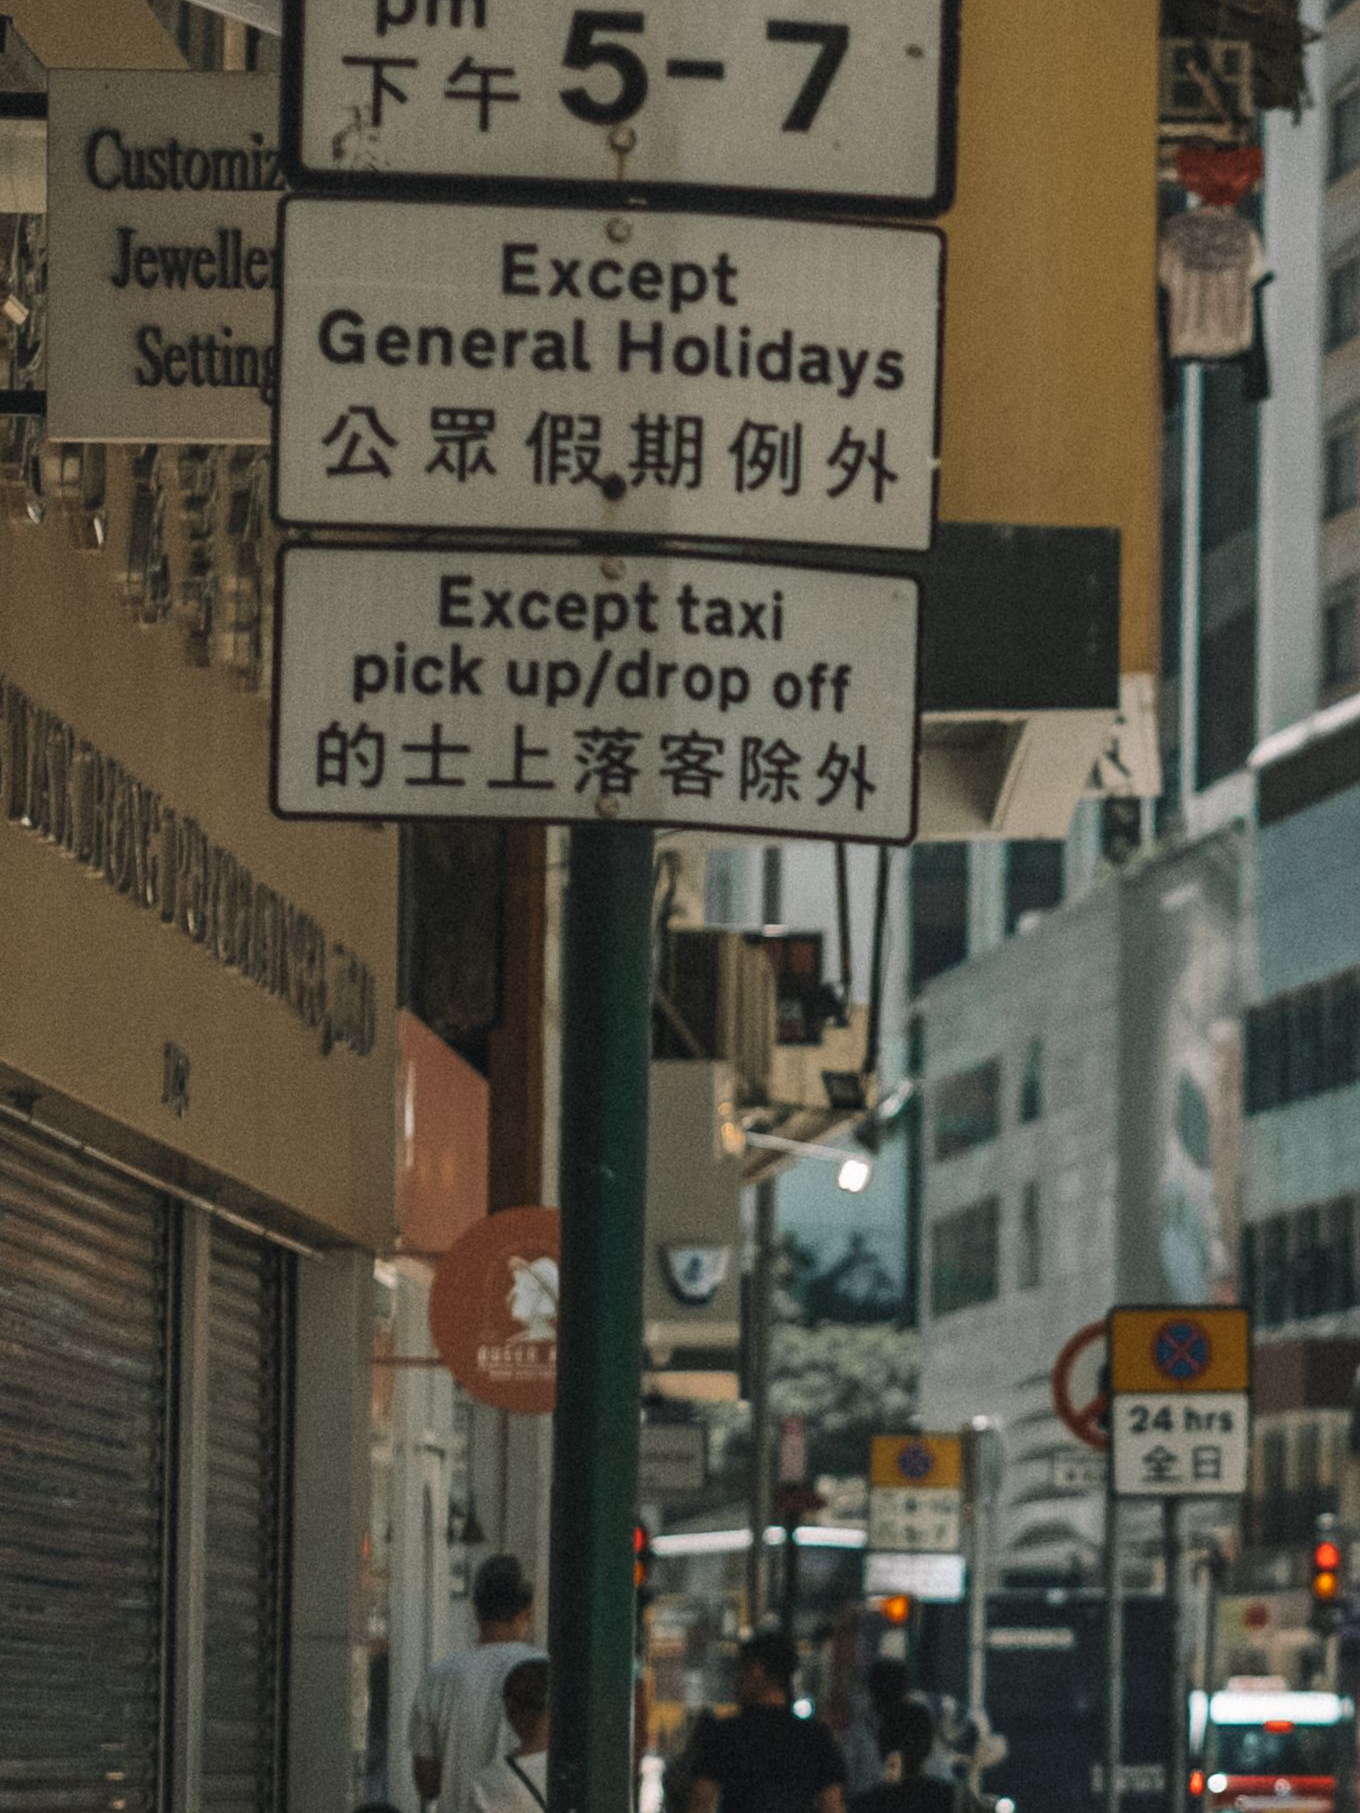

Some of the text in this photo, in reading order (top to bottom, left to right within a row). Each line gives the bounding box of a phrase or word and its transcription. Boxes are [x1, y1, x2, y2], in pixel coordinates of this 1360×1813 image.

[342, 54, 521, 132] 下午
[558, 8, 851, 134] 5-7
[111, 226, 277, 290] Jewelle
[502, 243, 739, 310] Except
[318, 308, 905, 399] General Holidays
[321, 405, 899, 505] 公眾假期例外
[439, 576, 784, 642] Except taxi
[353, 642, 852, 713] pick up/drop off
[315, 720, 876, 812] 的士上落客除外
[1129, 1404, 1233, 1433] 24 hrs
[1141, 1445, 1221, 1482] 全日
